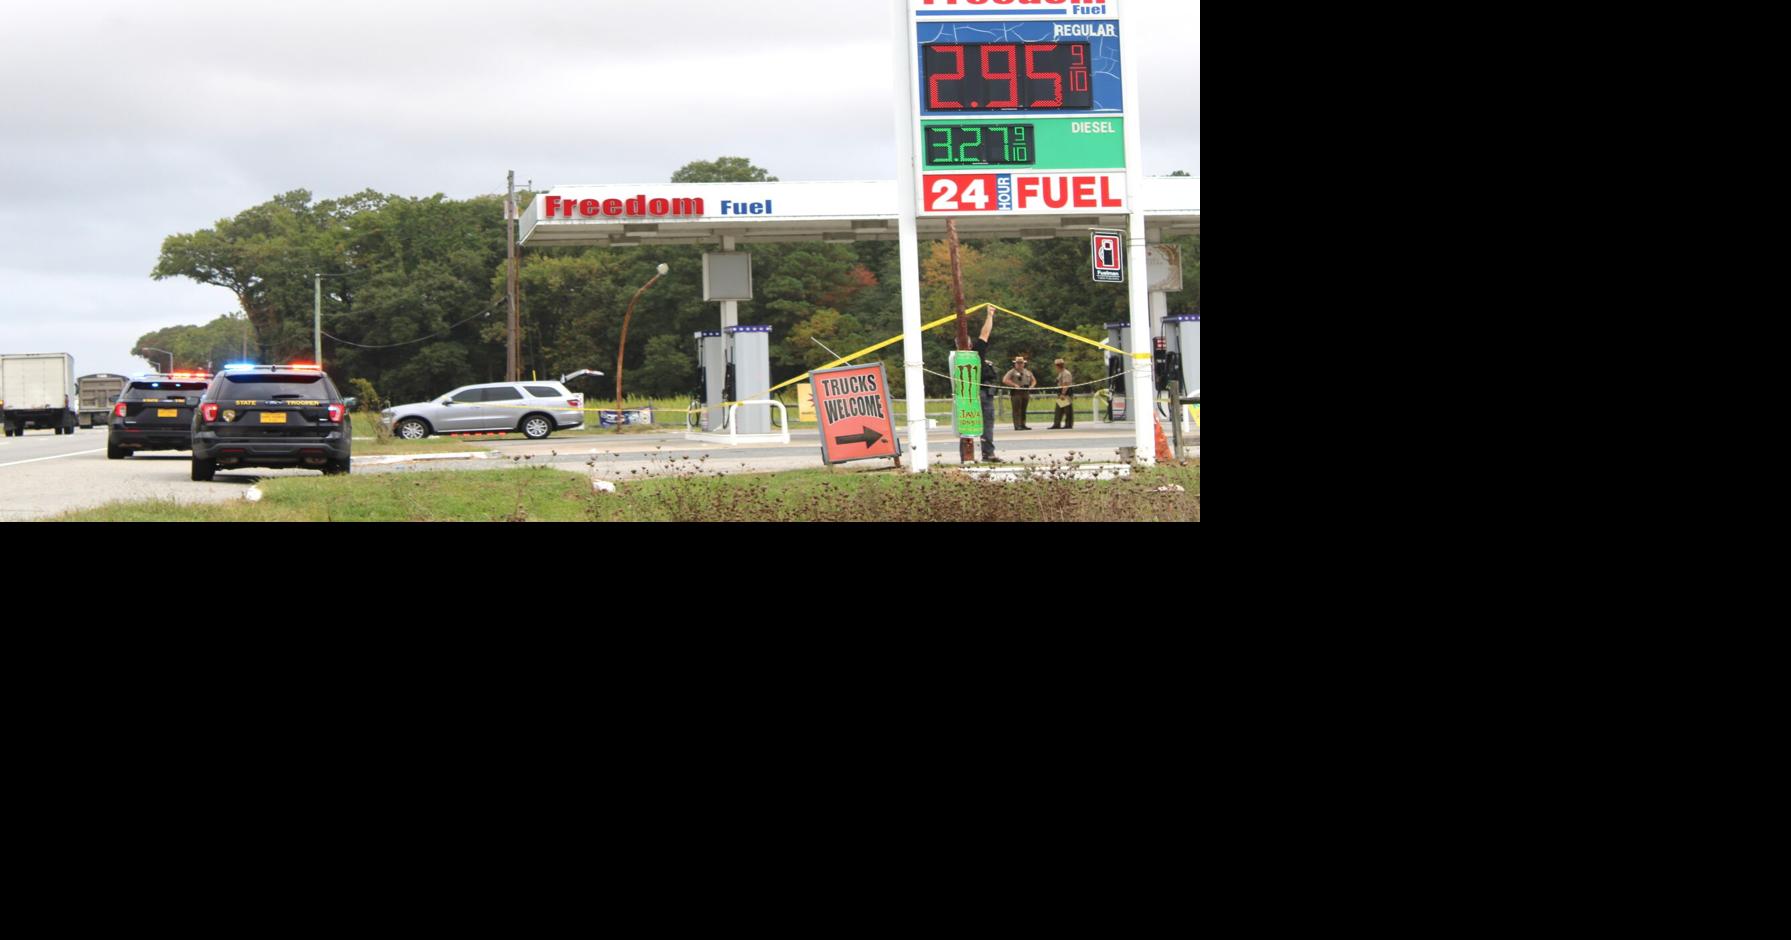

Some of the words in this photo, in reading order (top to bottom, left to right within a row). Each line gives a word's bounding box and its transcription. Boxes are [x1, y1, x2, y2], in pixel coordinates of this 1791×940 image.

[1072, 5, 1106, 15] Fuel
[1055, 24, 1115, 37] REGULAR
[930, 45, 1063, 108] 2.95
[1071, 45, 1083, 65] 9
[1069, 70, 1088, 91] 10
[1071, 121, 1115, 133] DIESEL
[931, 127, 1009, 162] 3.27
[1014, 127, 1025, 141] 9
[1012, 146, 1027, 162] 10
[931, 179, 989, 209] 24
[997, 177, 1011, 210] HOUR
[1017, 176, 1122, 208] FUEL
[545, 195, 704, 217] Freedom
[721, 200, 772, 215] Fuel
[822, 375, 877, 396] TRUCKS
[824, 395, 884, 424] WELCOME
